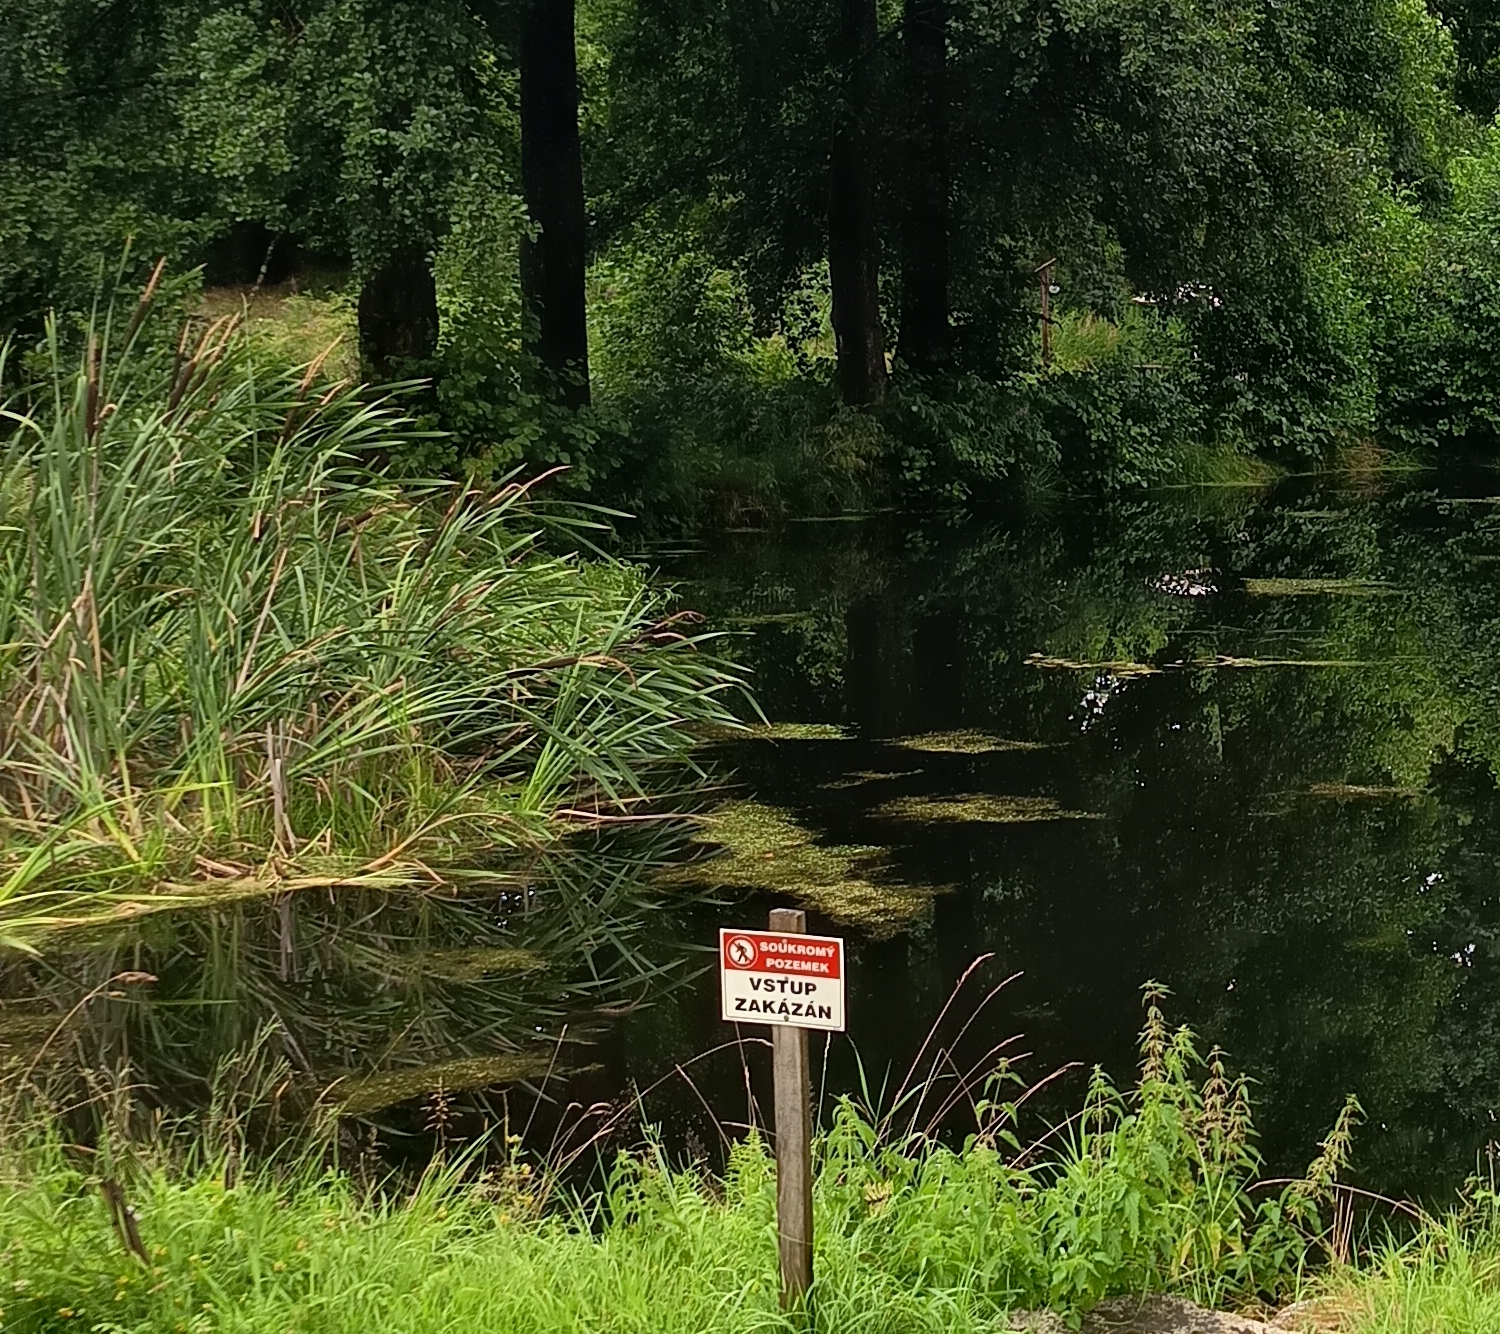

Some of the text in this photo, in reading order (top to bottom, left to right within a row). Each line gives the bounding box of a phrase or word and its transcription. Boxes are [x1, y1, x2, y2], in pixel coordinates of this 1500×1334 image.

[760, 941, 835, 958] SOUKROMÝ
[766, 958, 829, 973] POZEMEK
[749, 977, 817, 995] VSTUP
[735, 998, 832, 1019] ZAKÁZÁN
